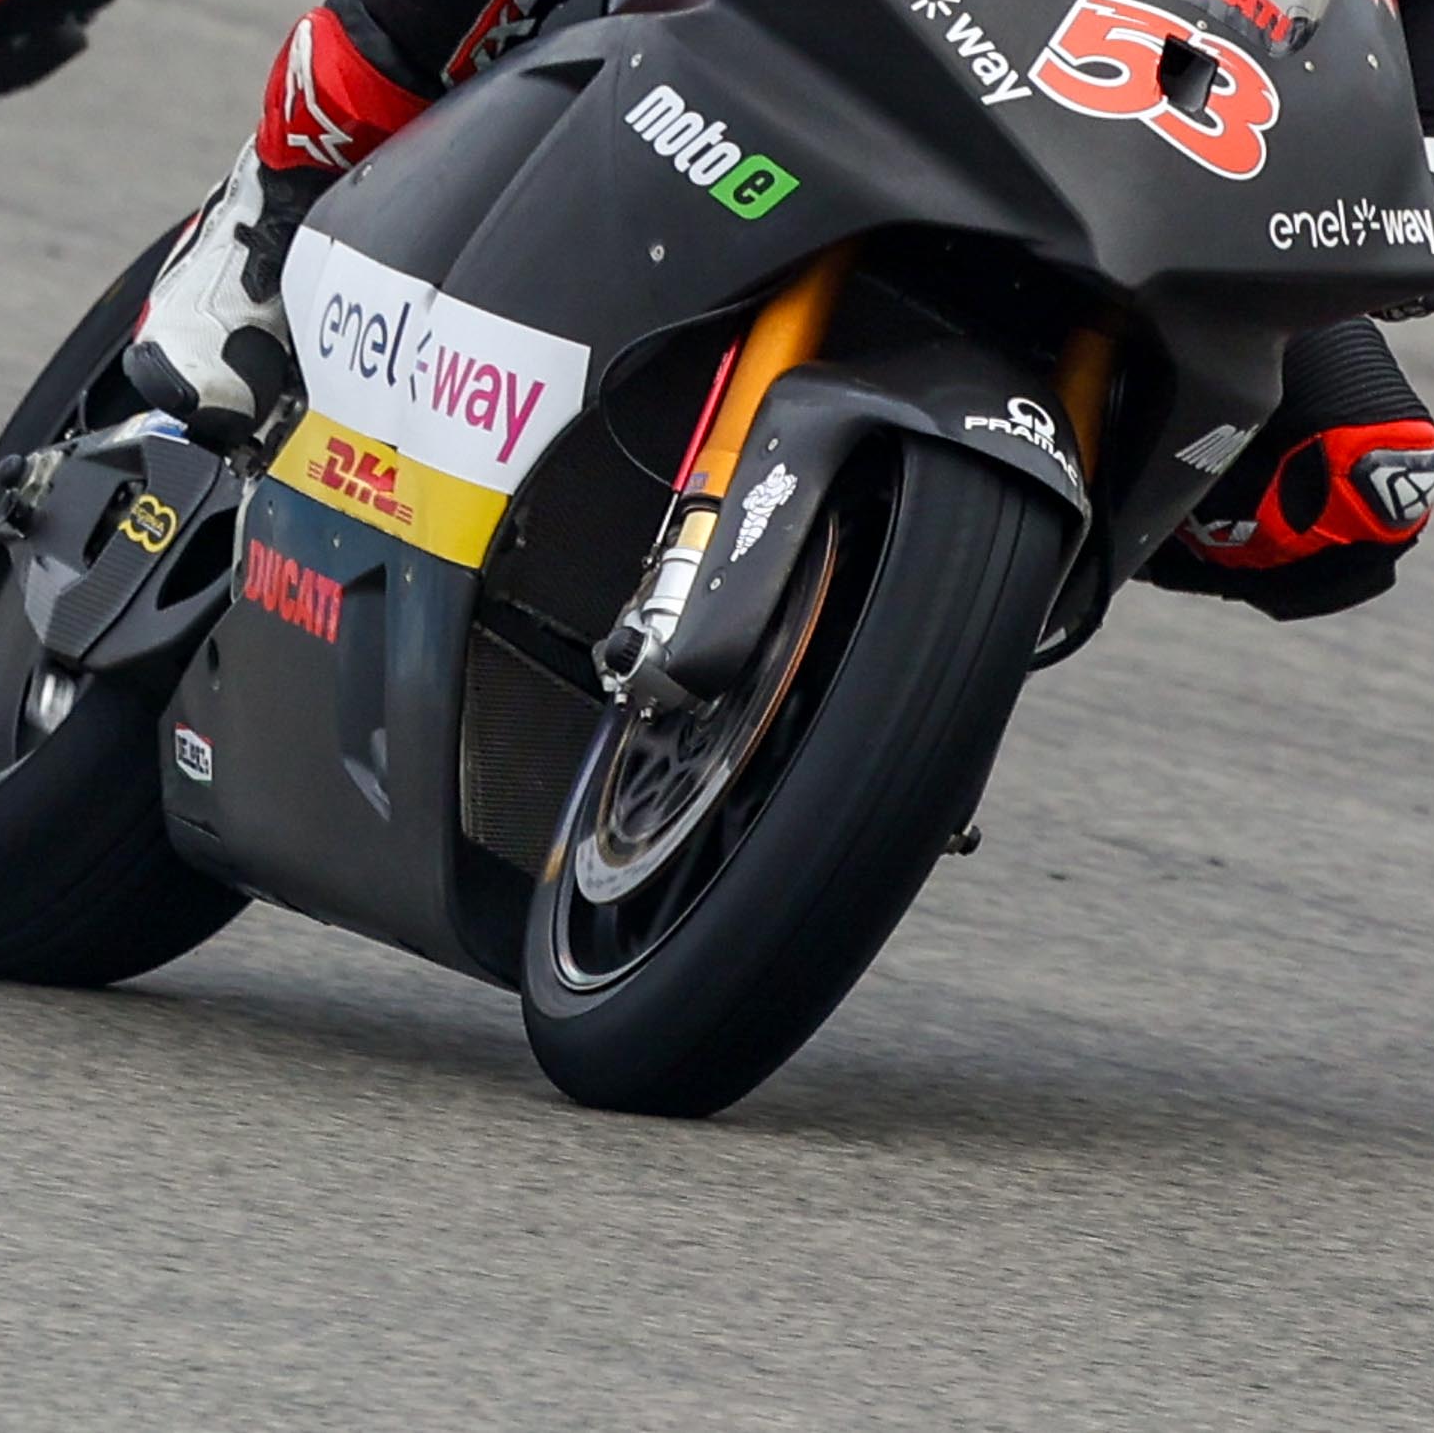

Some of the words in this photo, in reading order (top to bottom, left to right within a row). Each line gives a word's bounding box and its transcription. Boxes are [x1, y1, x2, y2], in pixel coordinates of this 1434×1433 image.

[944, 11, 1034, 107] way
[1269, 198, 1350, 251] enel
[318, 291, 411, 388] enel
[430, 344, 547, 465] way
[964, 415, 1079, 487] PRAMAC
[243, 536, 346, 646] DUCATI
